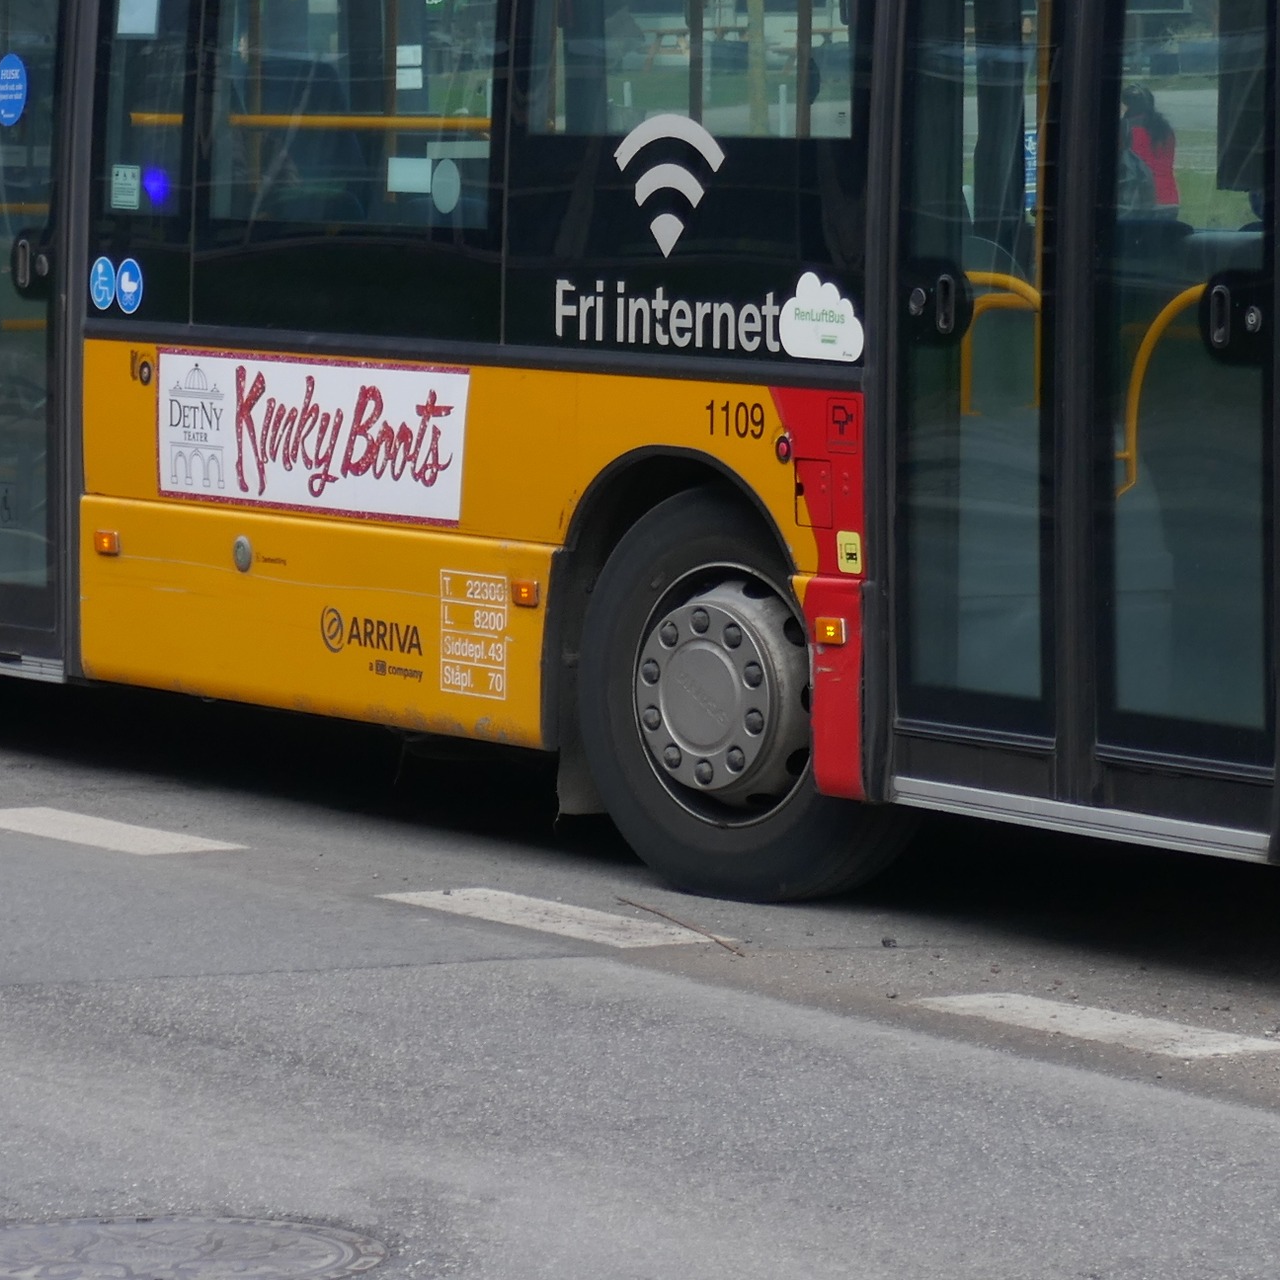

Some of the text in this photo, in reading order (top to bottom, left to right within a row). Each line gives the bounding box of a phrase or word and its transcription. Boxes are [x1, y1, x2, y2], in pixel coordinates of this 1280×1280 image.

[555, 277, 780, 353] Fri internet
[794, 307, 846, 324] RenLuftBus
[235, 365, 453, 498] Kinky Boots
[705, 400, 766, 440] 1109
[183, 430, 208, 443] TEATER
[443, 577, 453, 596] T.
[444, 605, 503, 631] L. 8200
[347, 616, 423, 657] ARRIVA
[443, 635, 503, 664] Siddepl. 43
[388, 665, 423, 683] company
[443, 665, 503, 693] Ståpl. 70
